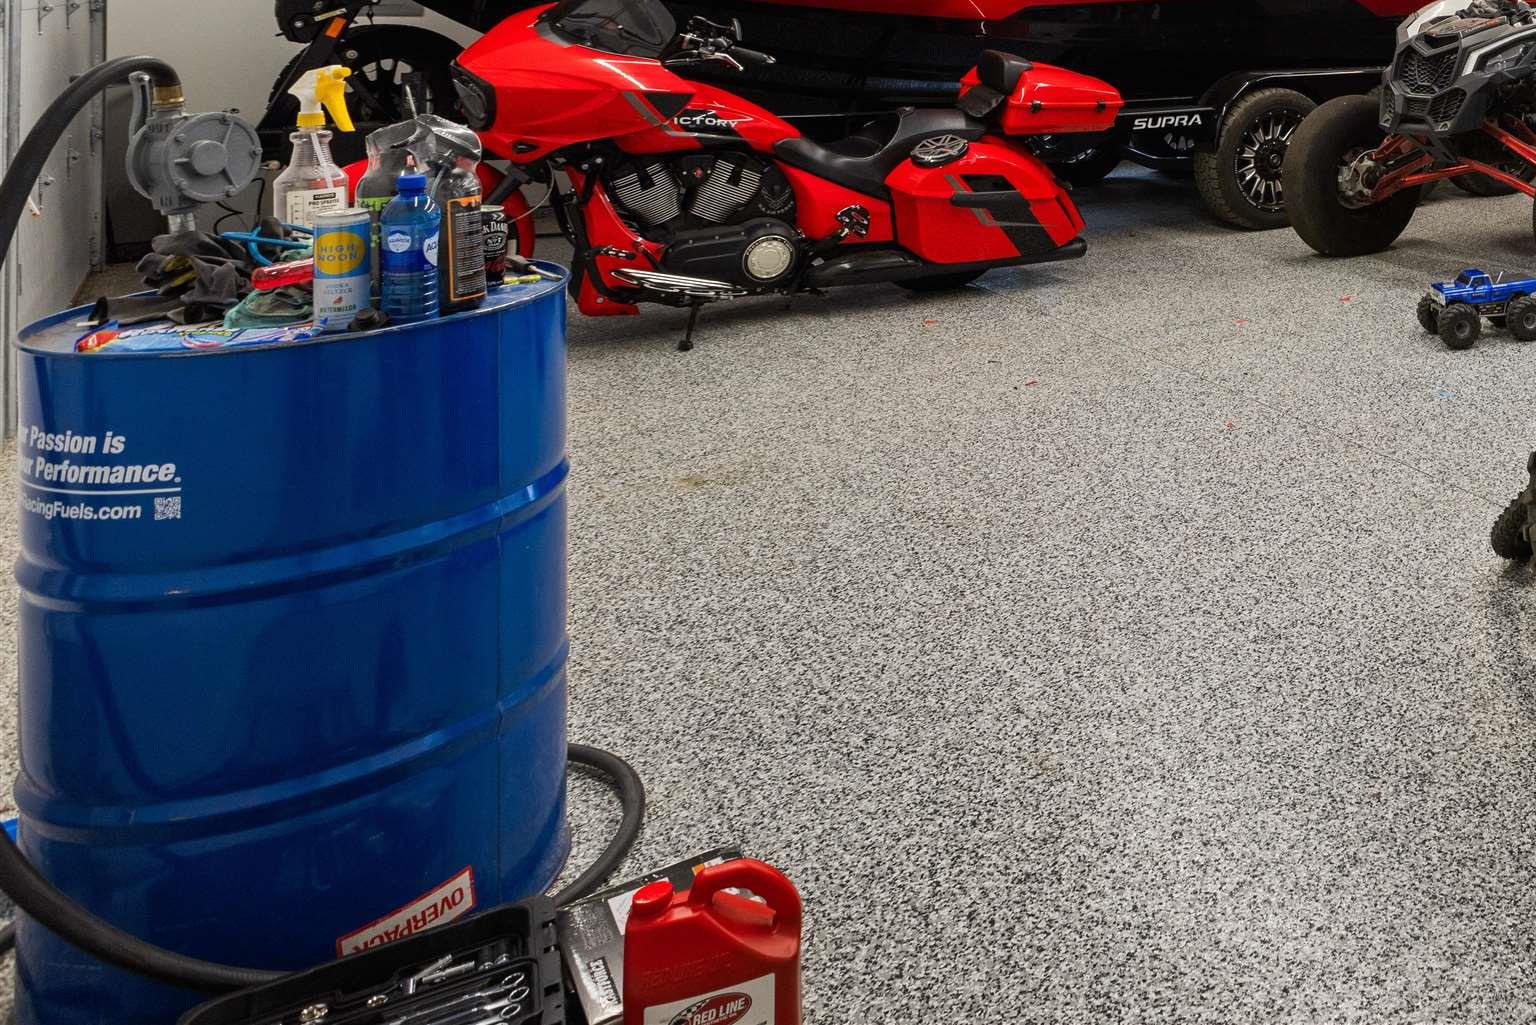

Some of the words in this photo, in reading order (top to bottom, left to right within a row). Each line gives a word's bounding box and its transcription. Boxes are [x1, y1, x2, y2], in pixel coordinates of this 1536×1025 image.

[1132, 113, 1203, 130] SUPRA
[320, 242, 356, 253] HIGH
[30, 426, 96, 454] Passion
[102, 431, 126, 454] is
[35, 456, 182, 484] Performance.
[692, 1007, 717, 1025] RED
[719, 996, 746, 1013] LINE
